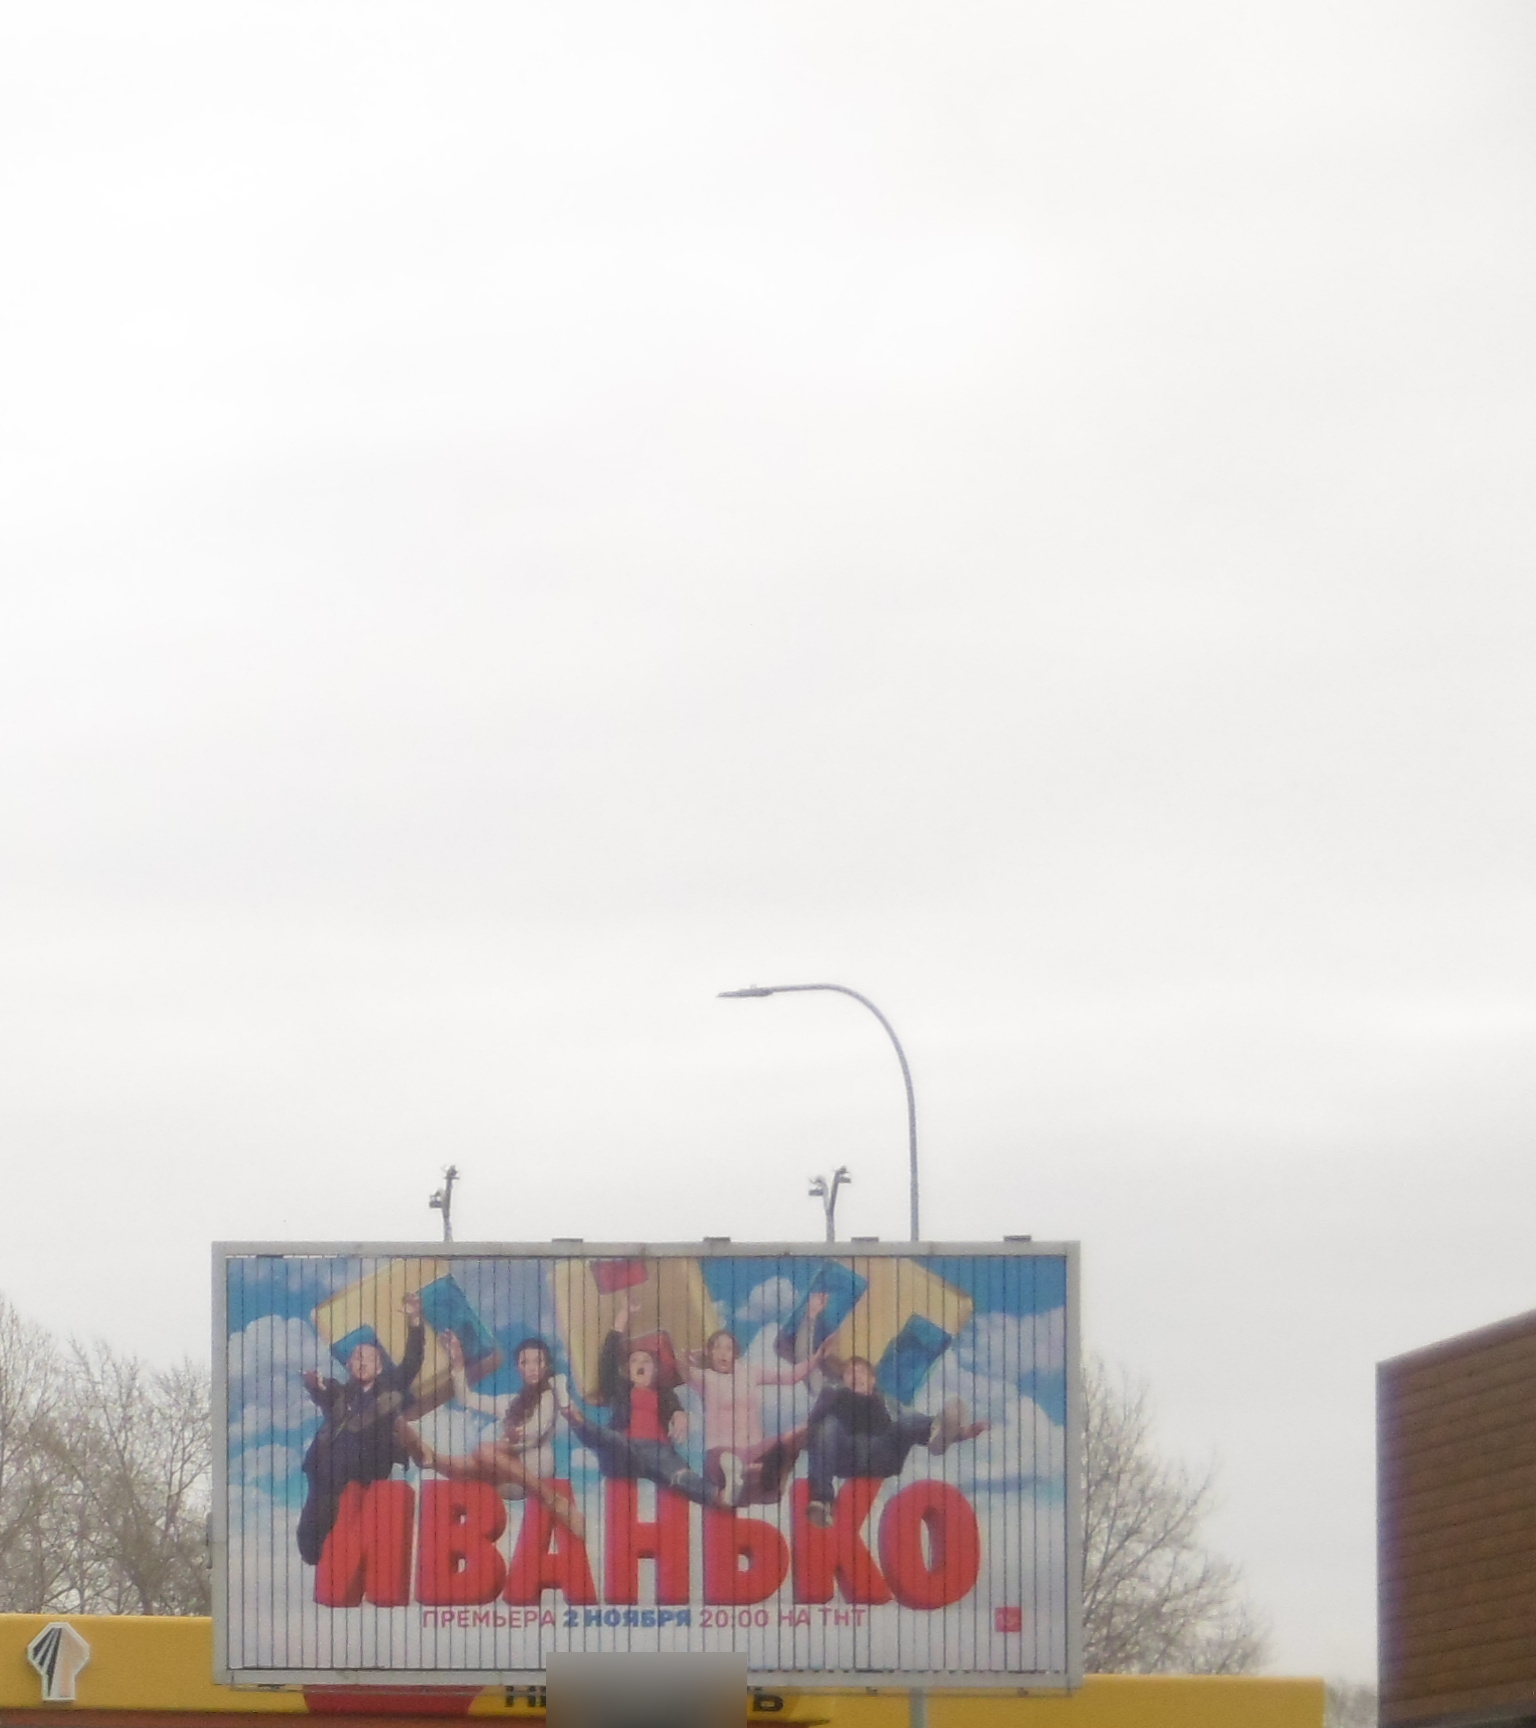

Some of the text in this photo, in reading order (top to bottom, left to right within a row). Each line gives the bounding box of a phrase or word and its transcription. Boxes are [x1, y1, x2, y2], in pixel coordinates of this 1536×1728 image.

[313, 1477, 981, 1609] ИВАНЬКО
[422, 1609, 866, 1629] ПРЕМЬЕРА 2 НОЯБРЯ 20:00 НА ТНТ
